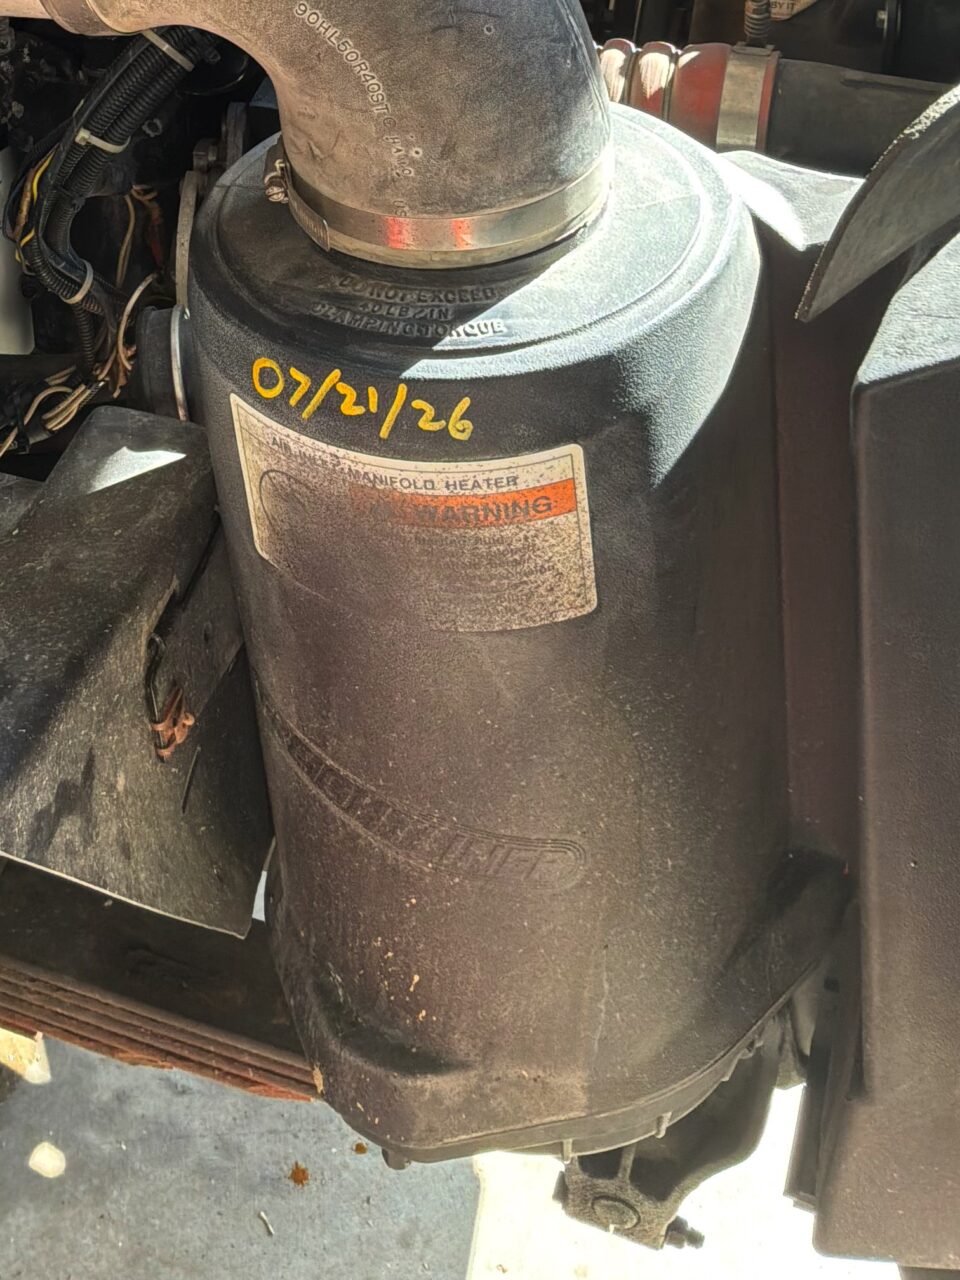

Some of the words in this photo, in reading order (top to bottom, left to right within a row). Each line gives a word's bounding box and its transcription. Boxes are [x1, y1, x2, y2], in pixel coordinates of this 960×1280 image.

[770, 2, 786, 10] BY
[368, 284, 409, 303] NOT
[416, 286, 498, 304] EXCEED
[418, 320, 508, 338] TORQUE
[251, 356, 474, 442] 07/21/26
[346, 463, 436, 491] MANIFOLD
[444, 475, 519, 492] HEATER
[415, 495, 553, 525] WARNING
